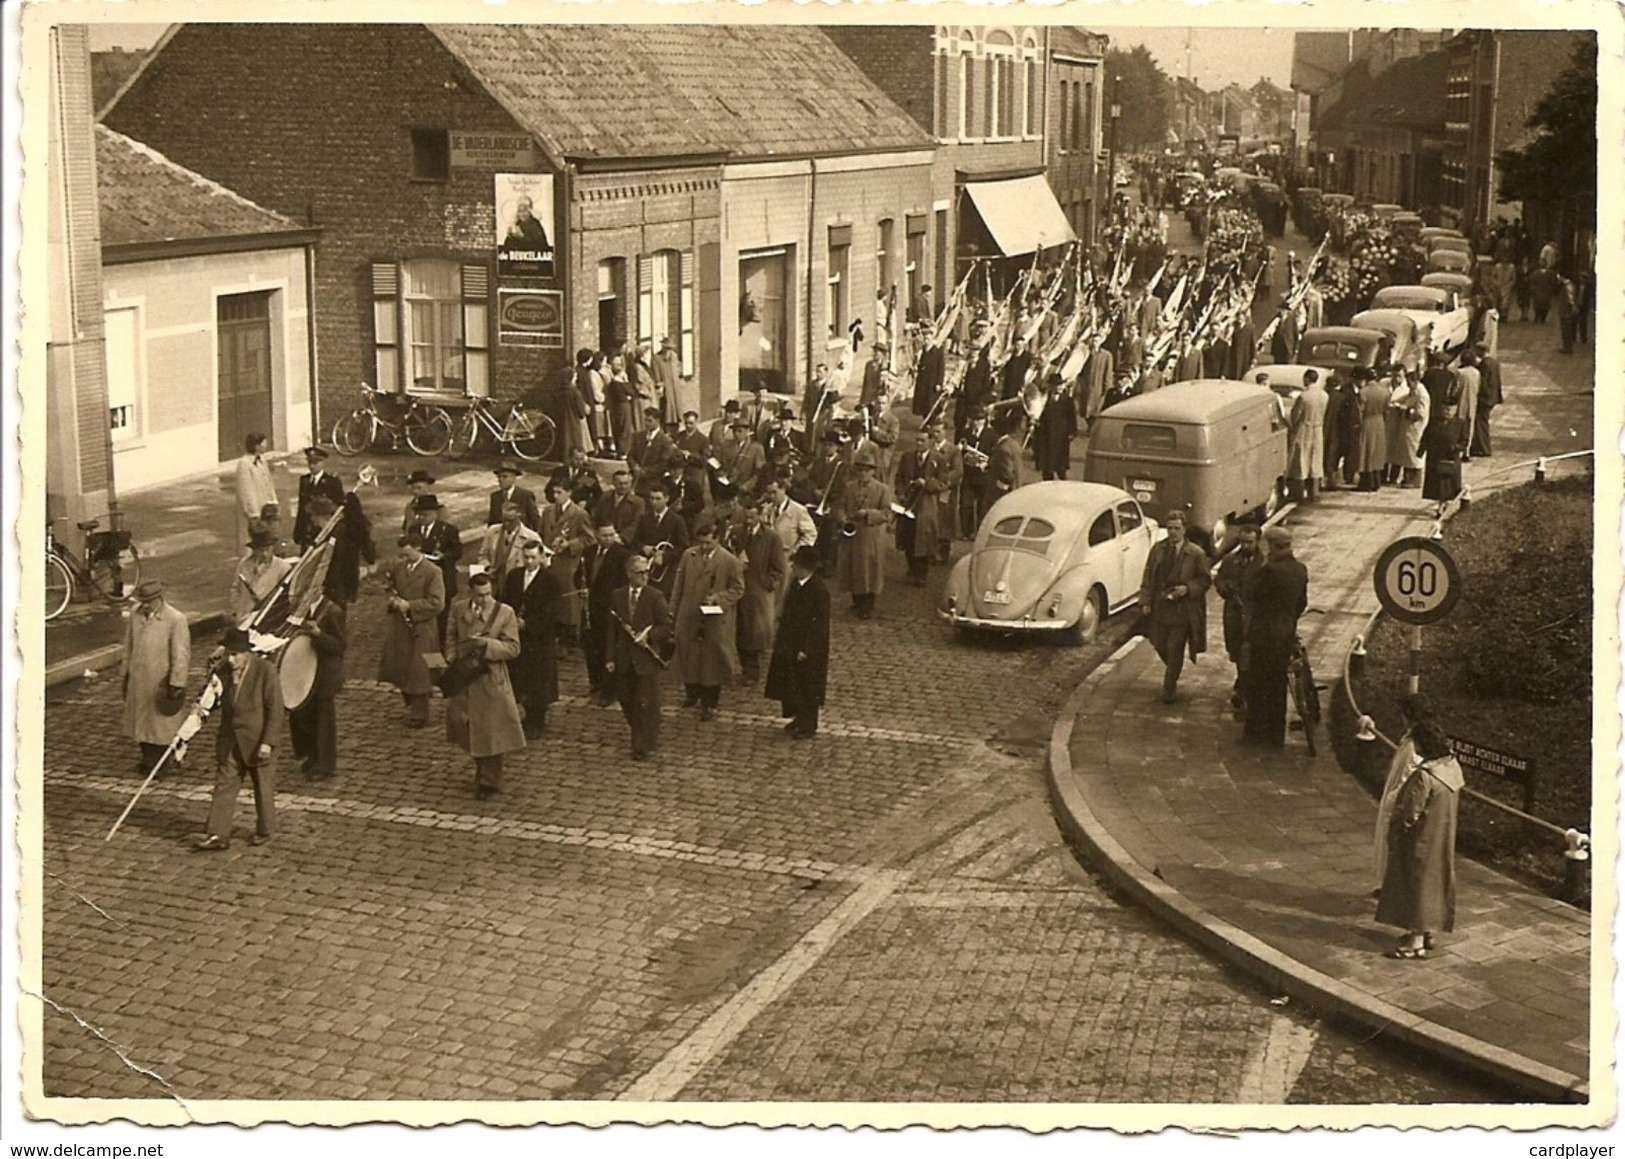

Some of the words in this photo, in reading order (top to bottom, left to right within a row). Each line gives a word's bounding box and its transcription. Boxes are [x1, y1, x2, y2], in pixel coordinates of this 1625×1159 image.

[498, 251, 508, 261] de
[509, 250, 554, 261] BEUKELAAR
[1398, 561, 1437, 597] 60
[1410, 596, 1425, 609] km
